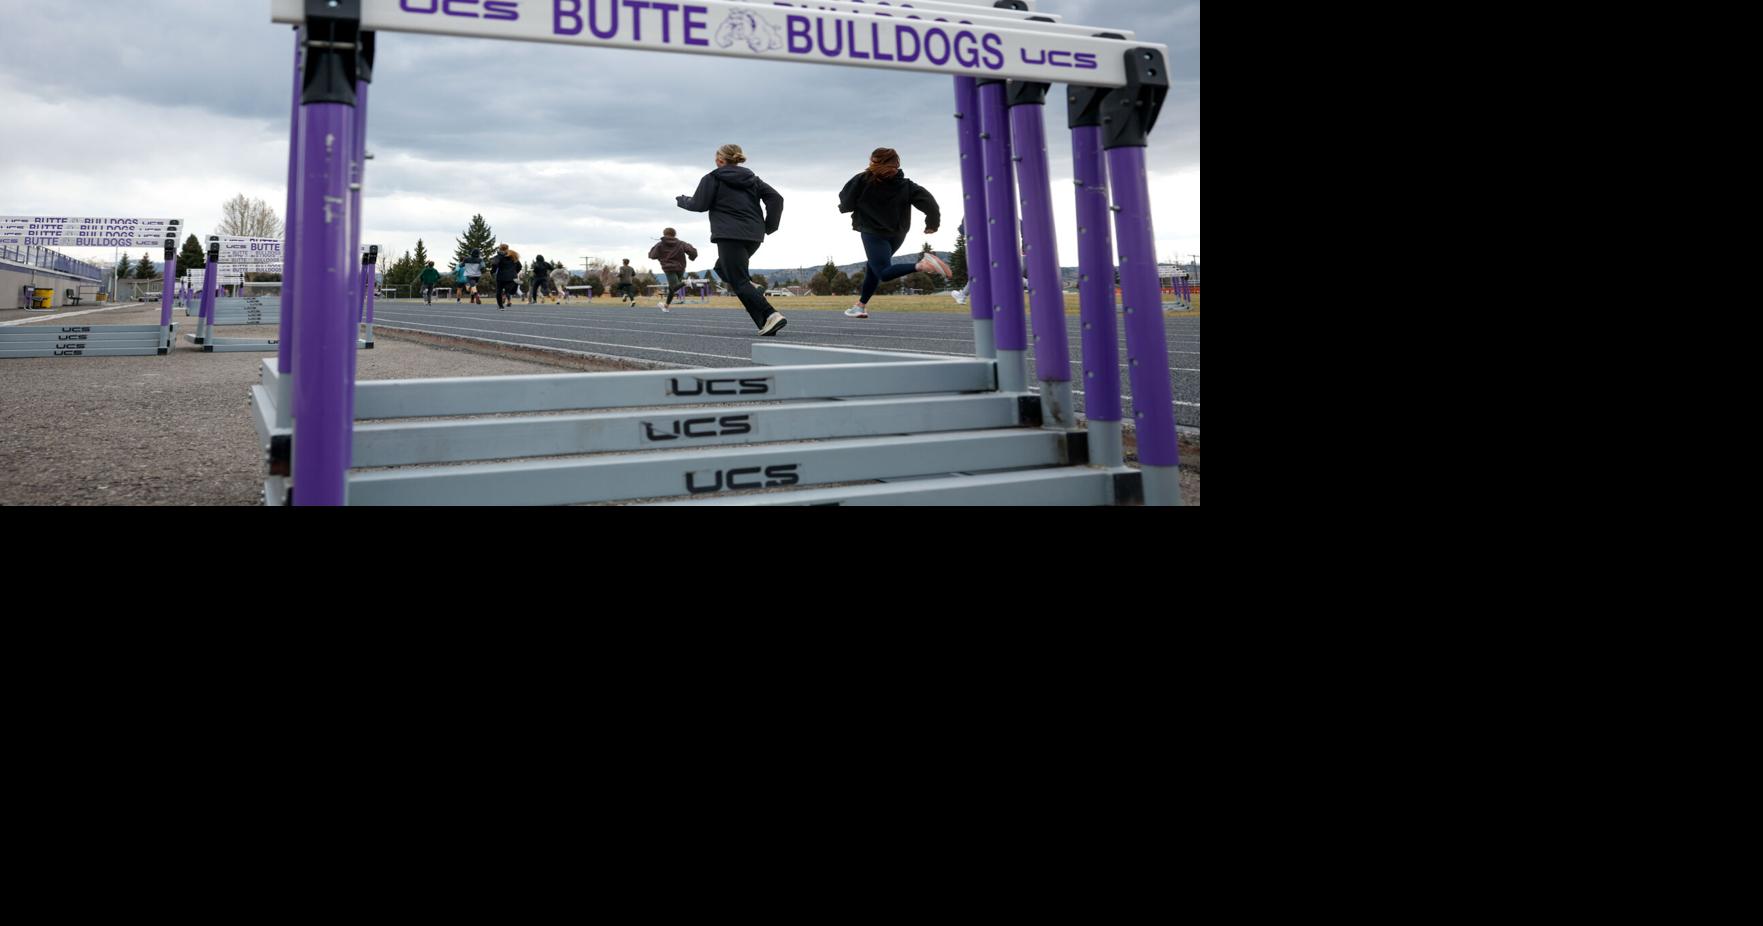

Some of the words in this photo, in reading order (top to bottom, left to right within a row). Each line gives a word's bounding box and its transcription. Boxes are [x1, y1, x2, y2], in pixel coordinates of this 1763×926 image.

[399, 0, 519, 21] UCS
[552, 0, 709, 46] BUTTE
[786, 14, 1004, 70] BULLDOGS
[1021, 47, 1098, 69] UCS
[24, 236, 59, 245] BUTTE
[76, 237, 132, 247] BULLDOGS
[251, 243, 280, 251] BUTTE
[670, 377, 770, 396] UCS
[645, 414, 751, 441] UCS
[685, 463, 800, 494] UCS
